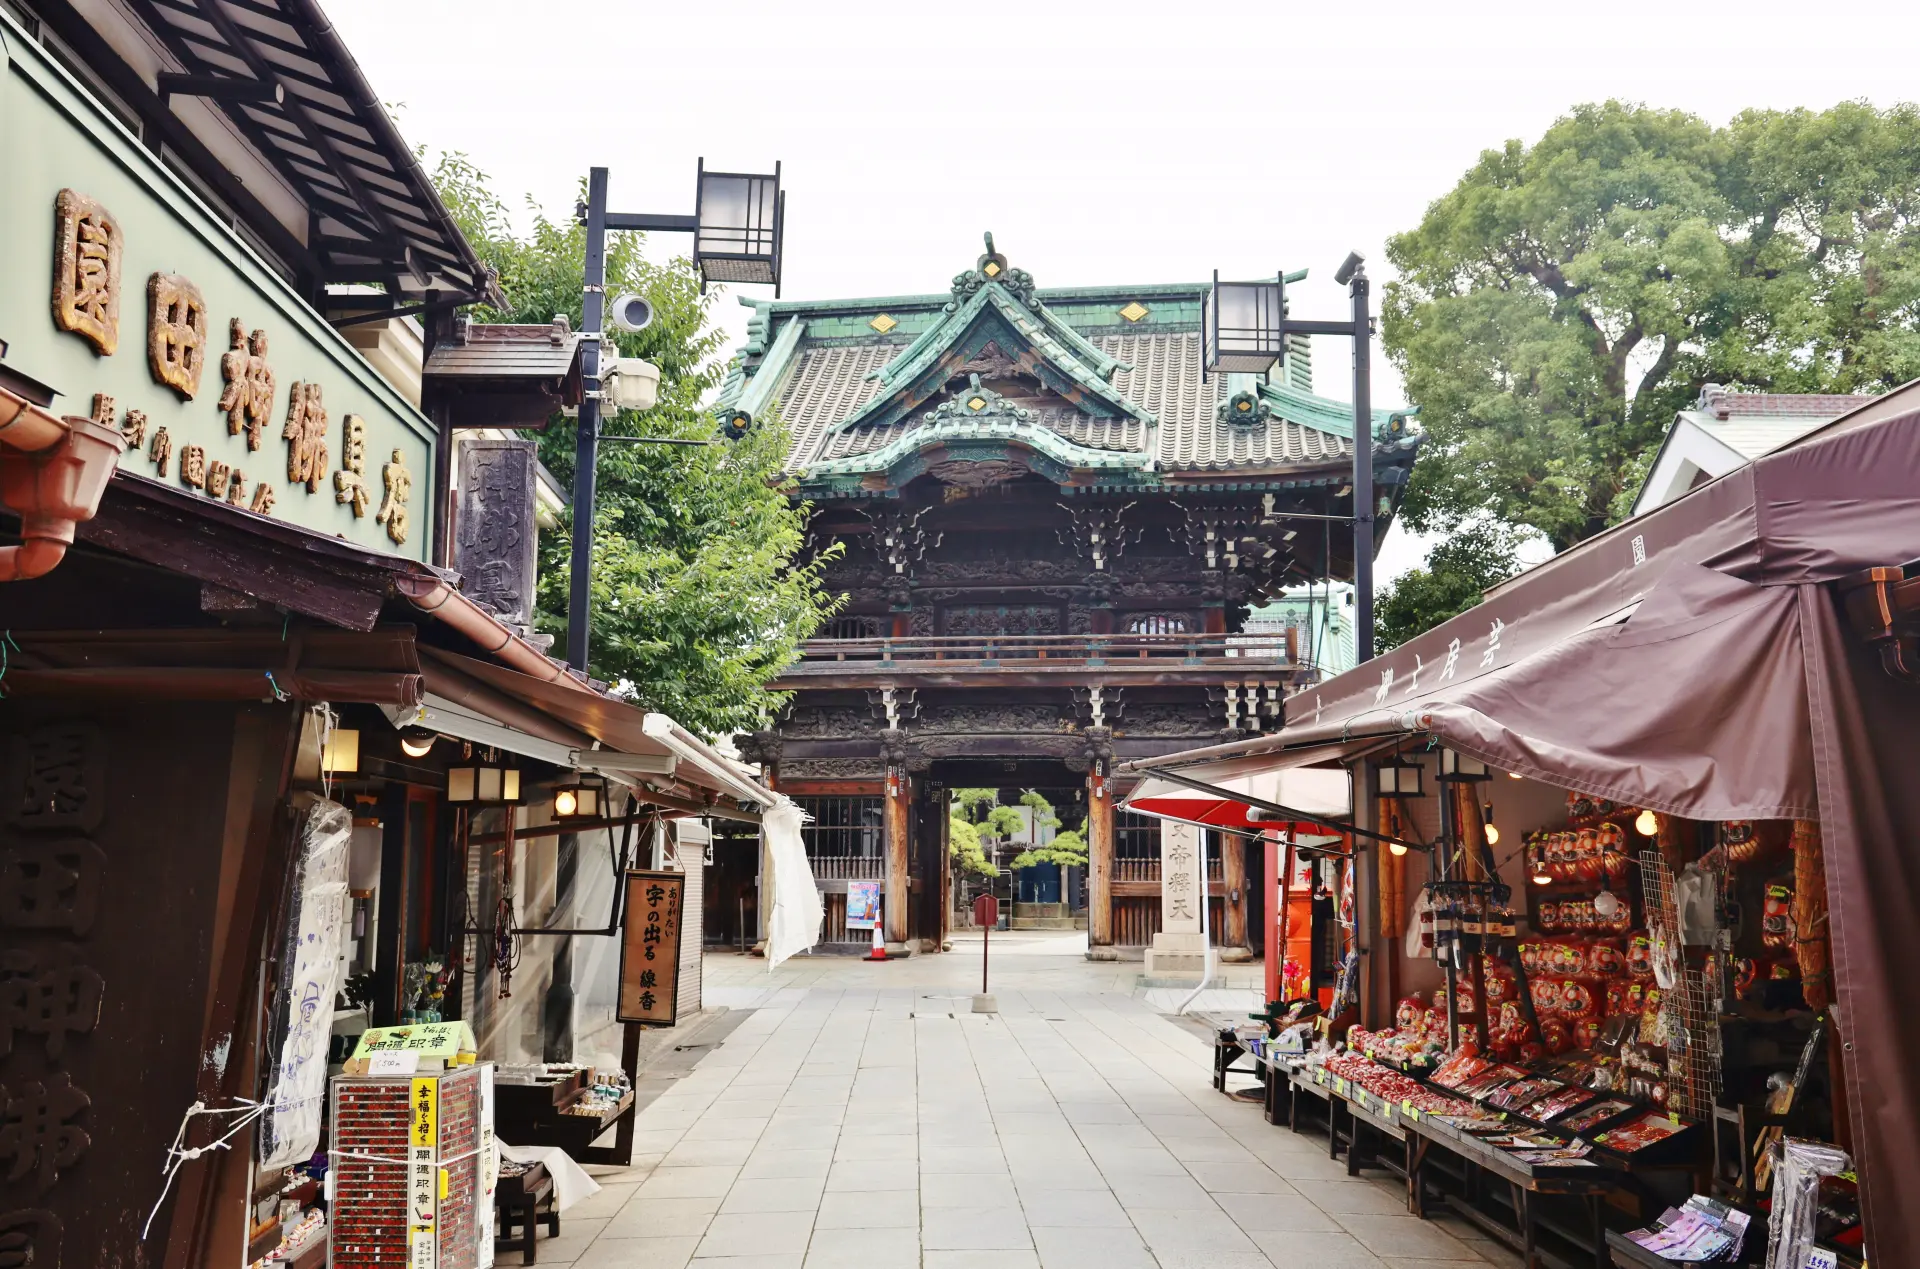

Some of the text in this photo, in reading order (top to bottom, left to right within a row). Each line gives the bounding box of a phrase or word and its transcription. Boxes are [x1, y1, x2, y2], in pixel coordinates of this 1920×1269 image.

[665, 887, 677, 938] ありがたい
[416, 1149, 430, 1205] 開運印章
